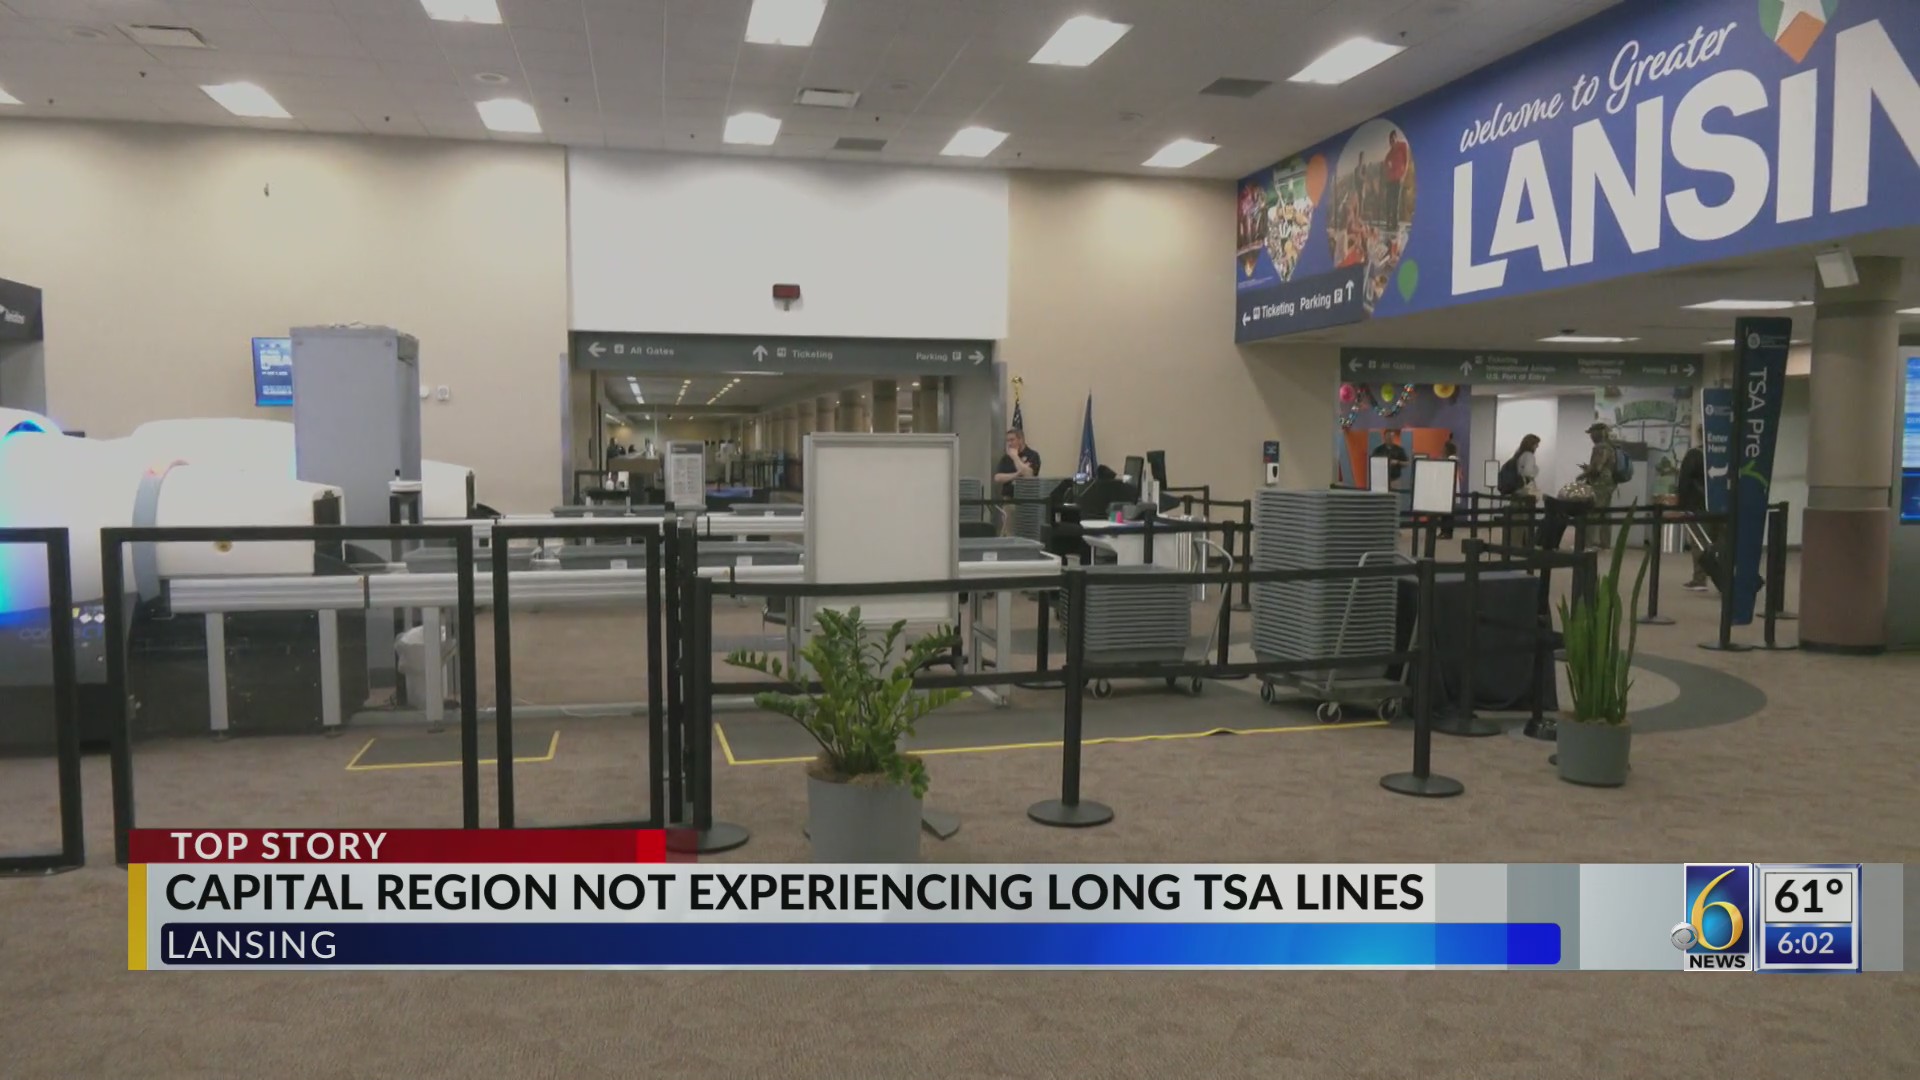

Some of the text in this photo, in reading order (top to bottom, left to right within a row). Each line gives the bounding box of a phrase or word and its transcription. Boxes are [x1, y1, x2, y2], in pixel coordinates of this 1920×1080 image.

[1460, 22, 1738, 152] welcome to Greater
[1300, 294, 1332, 310] Parking
[1262, 302, 1295, 319] Ticketing
[792, 350, 833, 360] Ticketing
[916, 352, 948, 361] Parking
[1745, 367, 1767, 458] TSA Pre
